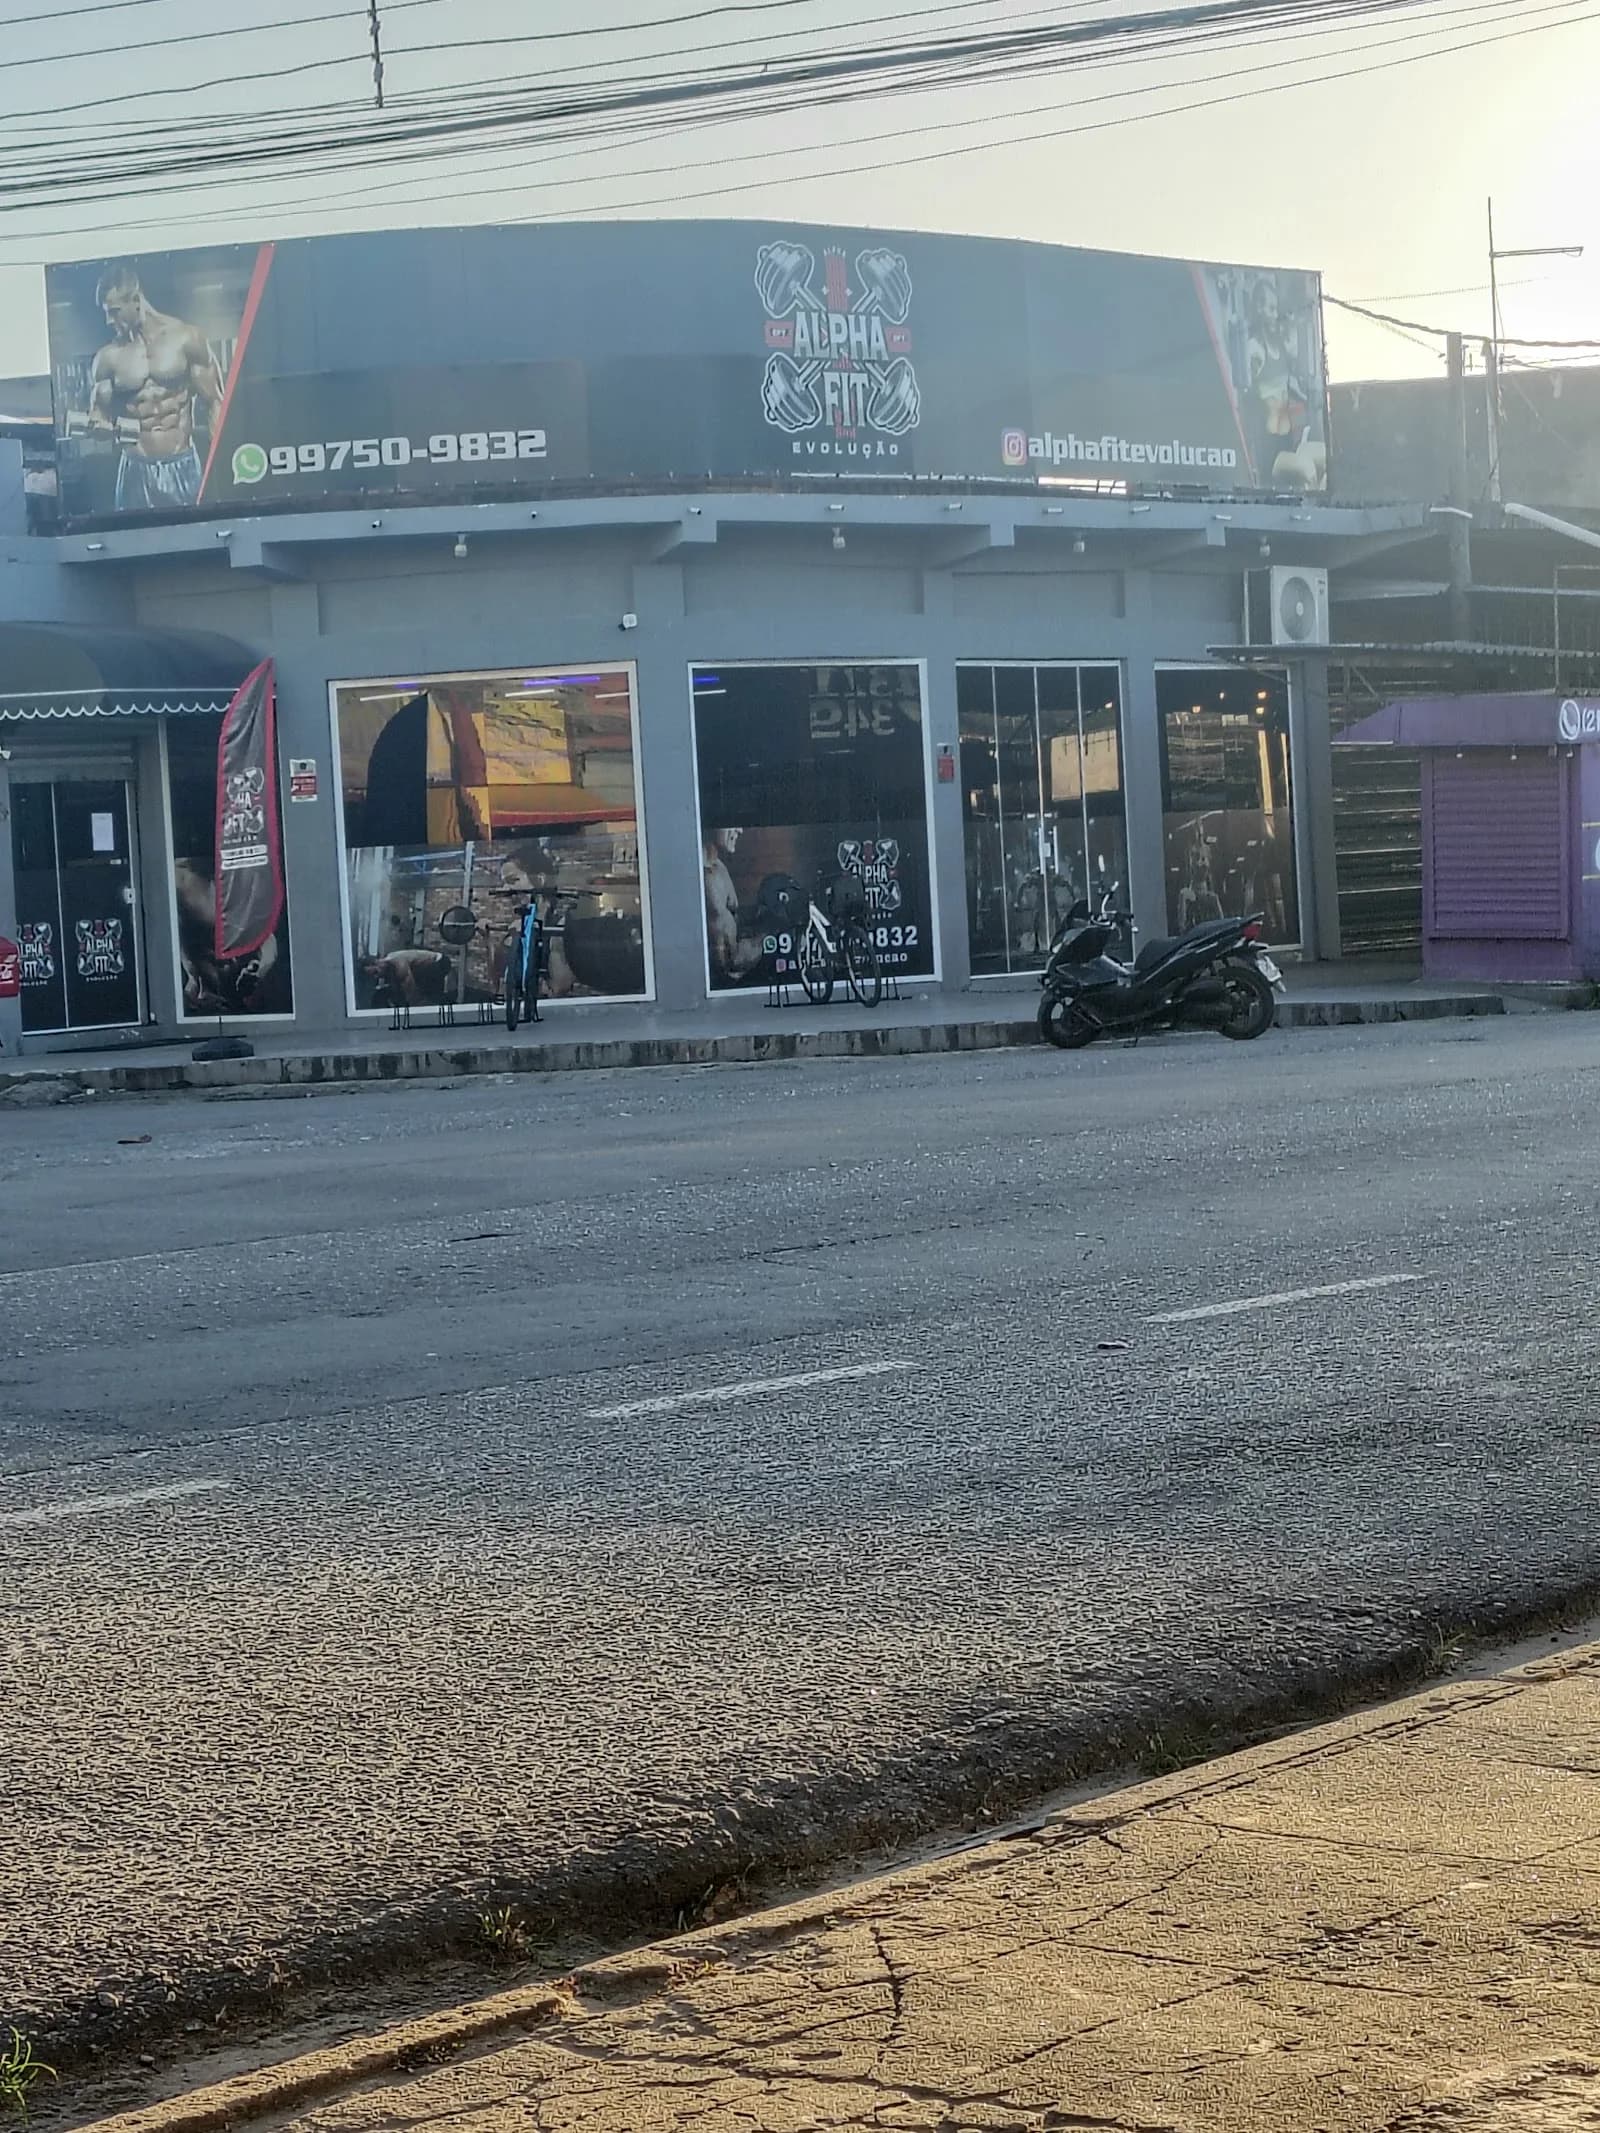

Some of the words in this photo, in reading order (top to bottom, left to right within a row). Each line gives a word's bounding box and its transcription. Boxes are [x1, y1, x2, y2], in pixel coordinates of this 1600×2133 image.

[793, 311, 889, 361] ALPHA
[823, 371, 870, 426] FIT
[269, 429, 547, 475] 99750-9832
[792, 441, 899, 459] EVOLUÇÃO
[1028, 432, 1237, 467] alphafitevolucao
